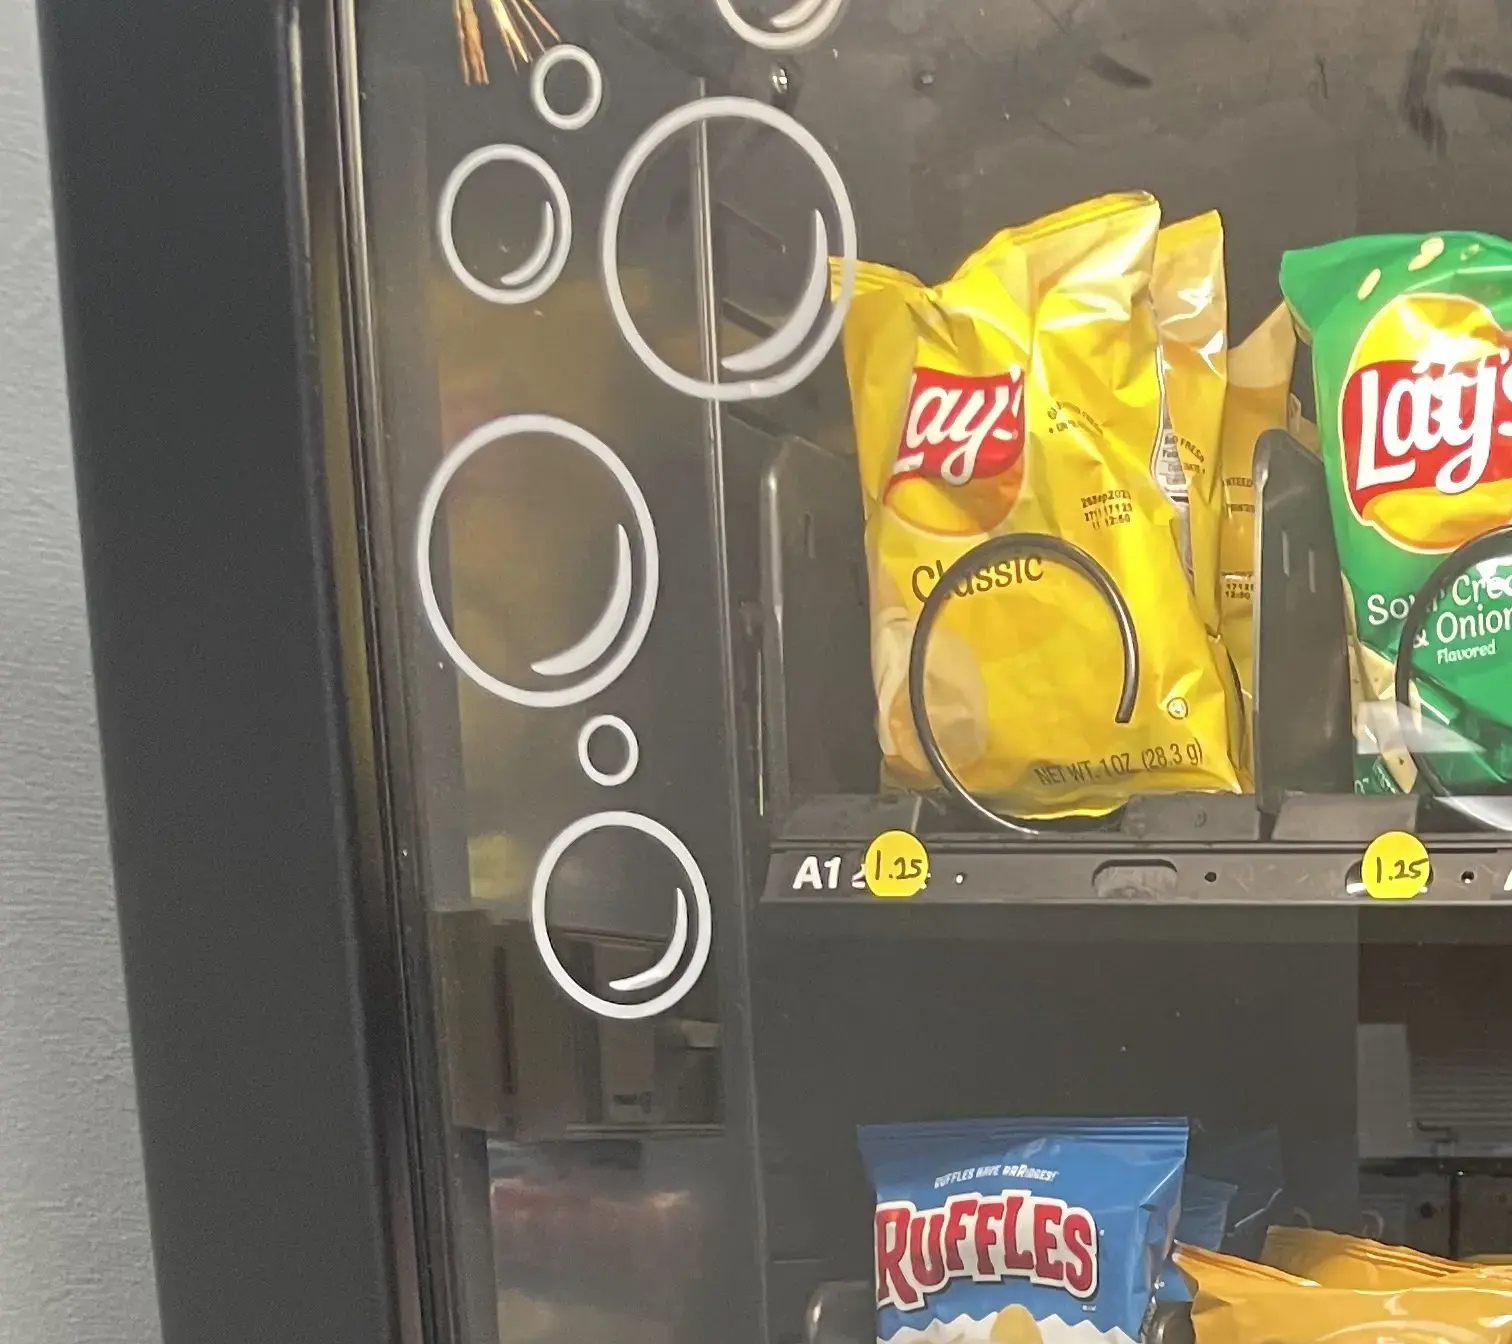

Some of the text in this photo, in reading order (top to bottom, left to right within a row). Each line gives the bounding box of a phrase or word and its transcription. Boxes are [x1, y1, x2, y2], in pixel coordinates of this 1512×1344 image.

[1368, 586, 1446, 626] Sor
[1437, 639, 1498, 665] Flavored
[792, 856, 840, 889] A1
[874, 849, 924, 881] 1.25
[1373, 853, 1428, 886] 1.25
[876, 1193, 1096, 1305] RUFFLES
